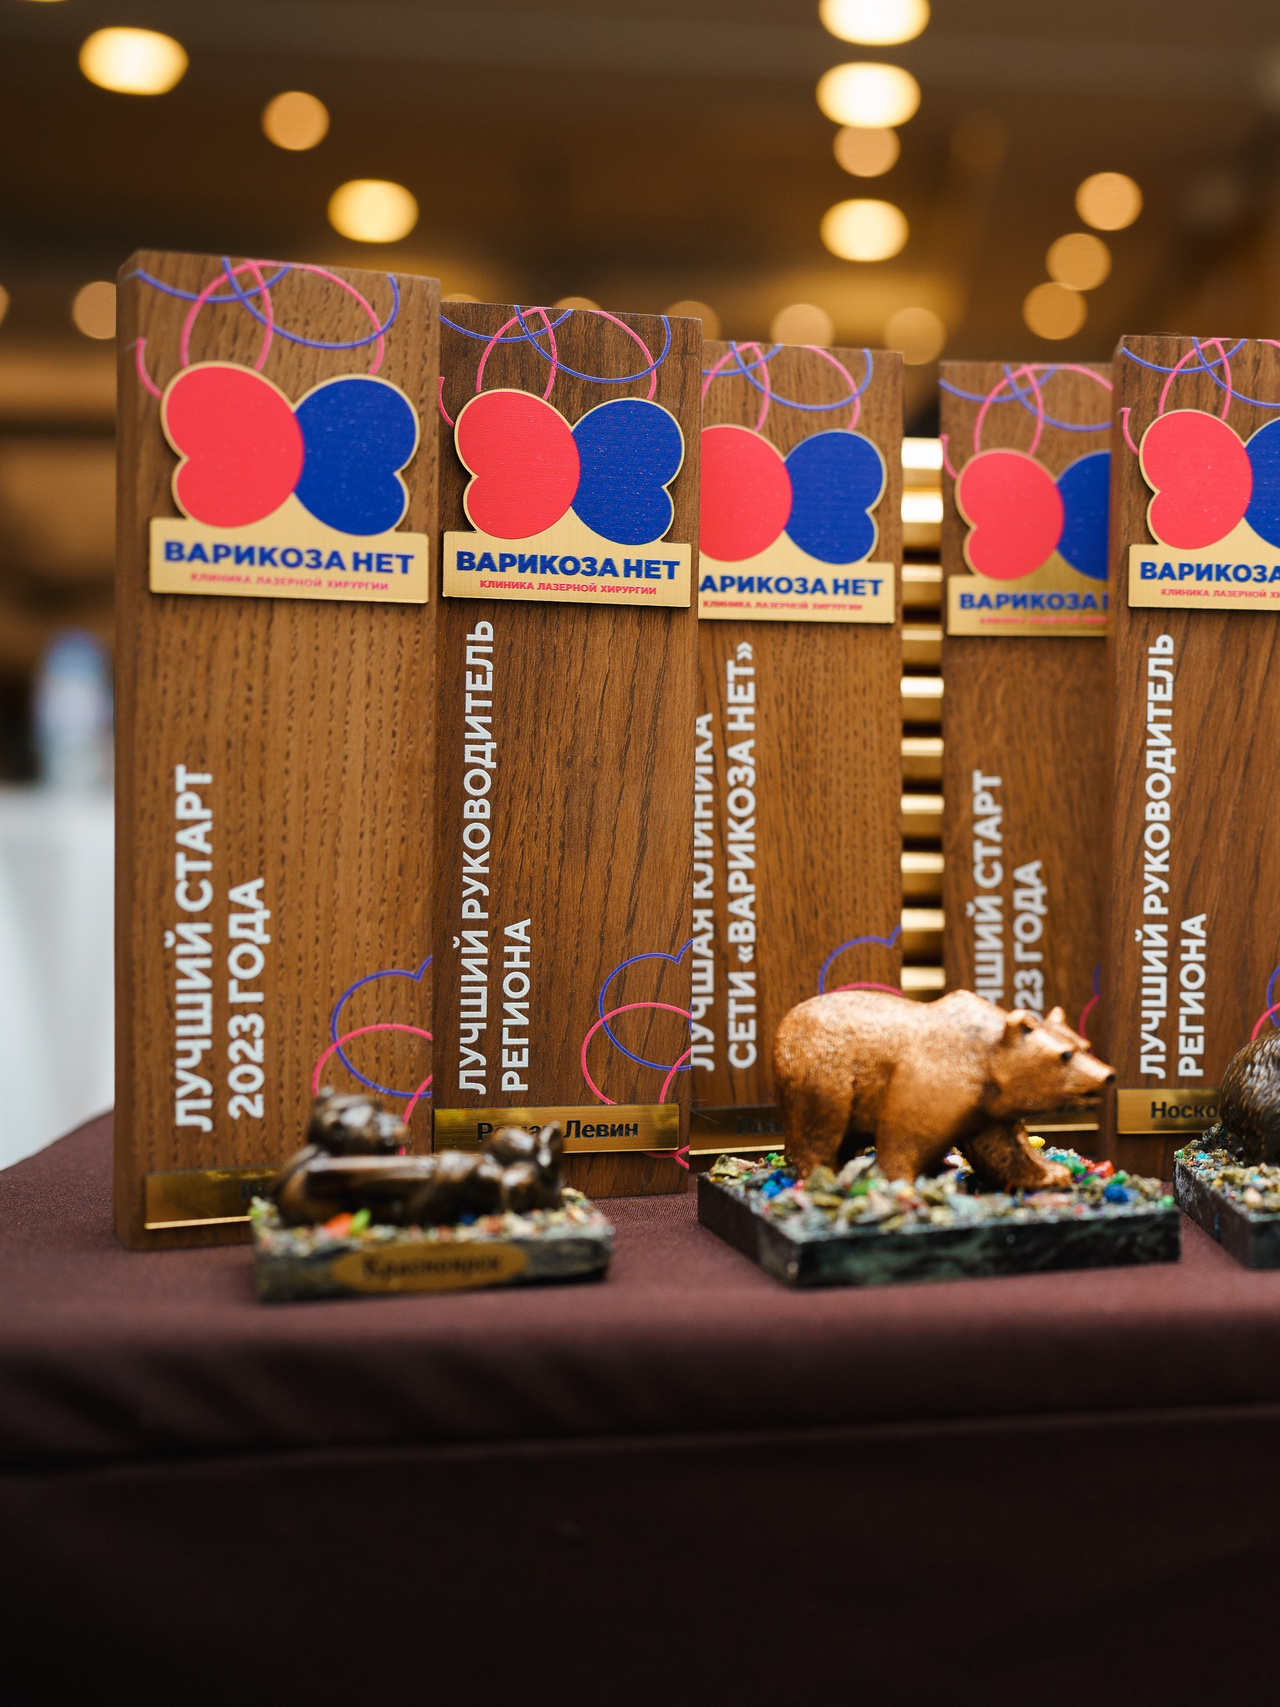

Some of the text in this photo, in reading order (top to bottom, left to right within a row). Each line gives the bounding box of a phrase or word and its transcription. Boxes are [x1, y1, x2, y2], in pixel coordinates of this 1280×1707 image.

[164, 541, 414, 574] ВАРИКОЗА НЕТ
[191, 572, 389, 591] КЛИНИКА ЛАЗЕРНОЙ ХИРУРГИИ
[456, 551, 680, 580] ВАРИКОЗА НЕТ
[480, 580, 657, 595] КЛИНИКА ЛАЗЕРНОЙ ХИРУРГИИ
[699, 575, 884, 596] АРИКОЗА НЕТ
[960, 593, 1098, 611] ВАРИКОЗА
[1161, 588, 1209, 598] КЛИНИКА
[1212, 589, 1267, 599] ЛАЗЕРНОЙ
[452, 620, 497, 1095] ЛУЧШИЙ РУКОВОДИТЕЛЬ
[726, 641, 757, 1069] СЕТИ «ВАРИКОЗА НЕТ»
[972, 769, 1004, 889] СТАРТ
[1135, 634, 1176, 1079] ЛУЧШИЙ РУКОВОДИТЕЛЬ
[164, 764, 213, 1132] ЛУЧШИЙ СТАРТ
[228, 877, 271, 1120] 2023 ГОДА
[501, 918, 531, 1091] РЕГИОНА
[691, 909, 715, 1072] ЛУЧШАЯ
[1013, 860, 1048, 1022] 23 ГОДА
[1177, 913, 1207, 1077] РЕГИОНА
[563, 1120, 639, 1139] Левин
